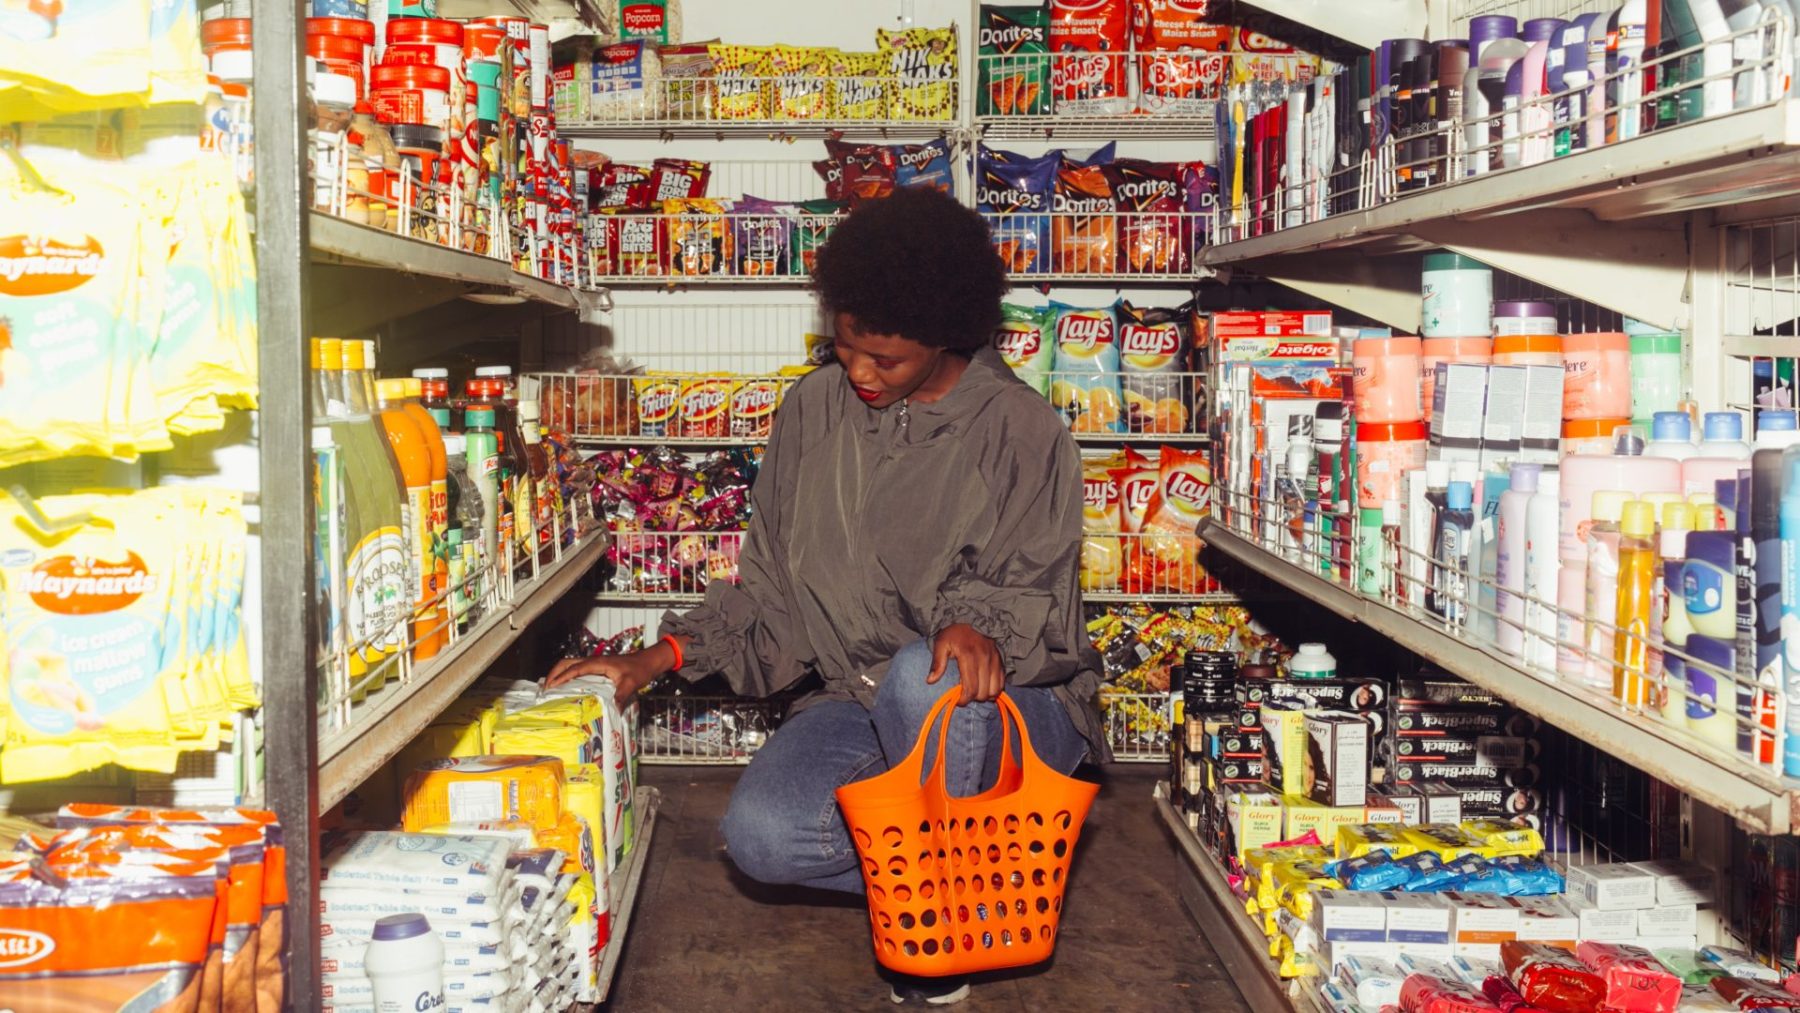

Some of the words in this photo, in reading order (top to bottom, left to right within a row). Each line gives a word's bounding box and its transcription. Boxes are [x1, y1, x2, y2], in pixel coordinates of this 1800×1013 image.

[625, 13, 661, 25] Popcorn
[1154, 20, 1184, 28] Cheese
[980, 26, 1043, 46] Doritos
[1071, 27, 1098, 36] Snack
[1162, 29, 1189, 38] Maize
[1190, 30, 1217, 38] Snack
[891, 47, 933, 74] NIK
[554, 70, 572, 81] corn
[902, 62, 953, 90] NAKS
[1155, 57, 1222, 84] Bbles
[843, 84, 883, 106] NAKS
[901, 147, 944, 165] Doritos
[662, 171, 693, 189] BIG
[977, 187, 1042, 209] Doritos
[1117, 180, 1178, 202] Doritos
[1053, 193, 1116, 213] Doritos
[622, 243, 654, 253] BITES
[0, 252, 104, 282] aynards
[995, 329, 1041, 361] ay's
[1278, 345, 1337, 357] Colgate
[1353, 365, 1367, 377] ere
[682, 389, 727, 417] Fritos
[734, 388, 777, 414] Fritos
[1084, 479, 1119, 512] ay's
[1169, 471, 1211, 511] Lay
[16, 569, 158, 600] Maynards
[61, 633, 89, 653] ice
[90, 621, 145, 646] cream
[76, 642, 146, 673] mallow
[1271, 686, 1344, 699] Superack
[1308, 722, 1329, 736] Glory
[1421, 716, 1498, 727] SuperBlack
[1421, 742, 1477, 753] erBlack
[1421, 767, 1498, 778] SuperBlack
[1462, 790, 1503, 804] Super
[1248, 811, 1275, 821] Glory
[1294, 813, 1321, 823] Glory
[1331, 814, 1359, 824] Glory
[1370, 813, 1398, 823] Glory
[1630, 974, 1661, 993] LUX
[414, 990, 446, 1013] Cere
